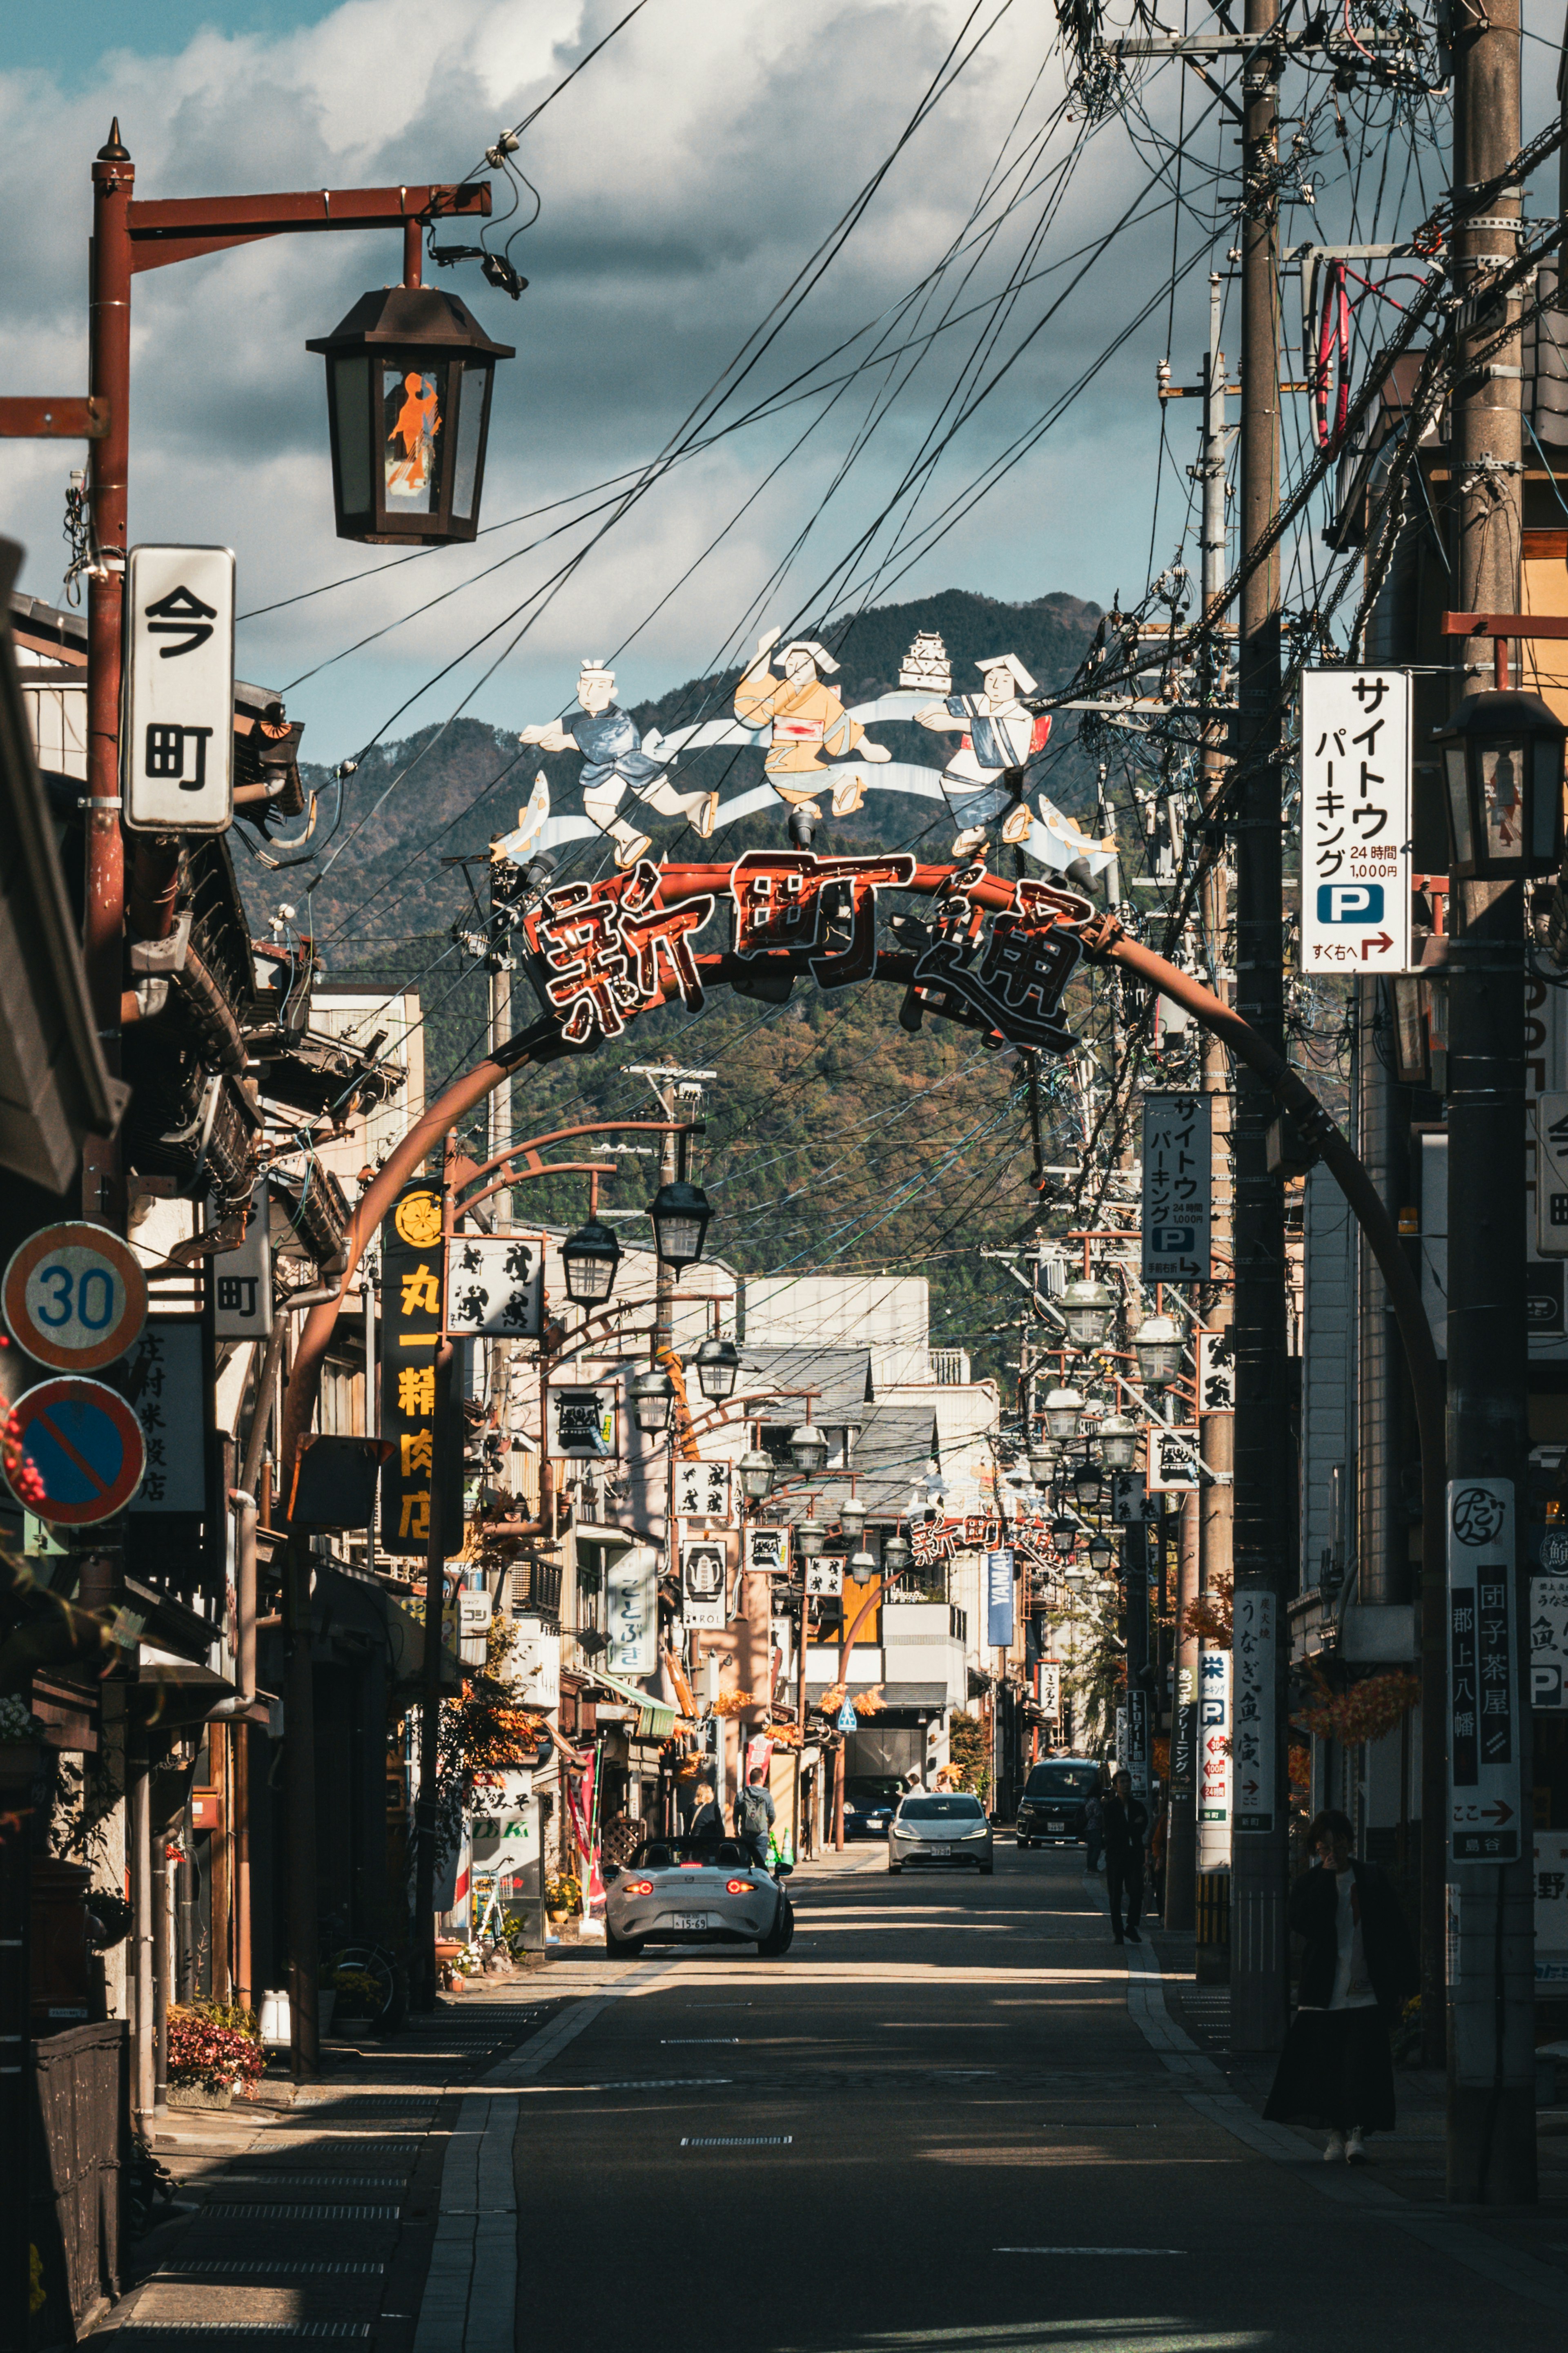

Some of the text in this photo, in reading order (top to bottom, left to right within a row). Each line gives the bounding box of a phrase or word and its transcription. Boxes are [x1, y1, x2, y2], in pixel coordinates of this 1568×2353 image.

[145, 585, 217, 791] 今町
[1352, 677, 1389, 840] サイトウ
[1315, 728, 1346, 878] パーキング
[1350, 864, 1397, 878] 1,000円
[1331, 887, 1370, 921] P
[542, 849, 1095, 1056] 新町通
[1313, 944, 1358, 961] すぐ右へ
[1174, 1098, 1197, 1199] サイトウ
[1151, 1130, 1171, 1224] パーキング
[1173, 1215, 1203, 1224] 1,000円
[1161, 1229, 1186, 1251] P
[1148, 1263, 1177, 1274] 手前右折
[38, 1265, 114, 1330] 30
[398, 1264, 439, 1540] 丸一精肉店
[621, 1579, 642, 1665] ことぶき
[1481, 1584, 1509, 1715] 団子茶屋
[1201, 1657, 1224, 1679] 栄
[1453, 1607, 1475, 1737] 郡上八幡
[1531, 1667, 1559, 1704] P
[1176, 1668, 1193, 1773] あづまクリーニング
[1203, 1702, 1223, 1722] P
[1207, 1765, 1225, 1773] 100円
[1205, 1788, 1225, 1797] 24時間
[1243, 1798, 1258, 1806] ここ
[1242, 1818, 1259, 1826] 新町
[1454, 1805, 1479, 1822] ここ
[1466, 1838, 1500, 1852] 島谷
[682, 1920, 706, 1928] 15-69
